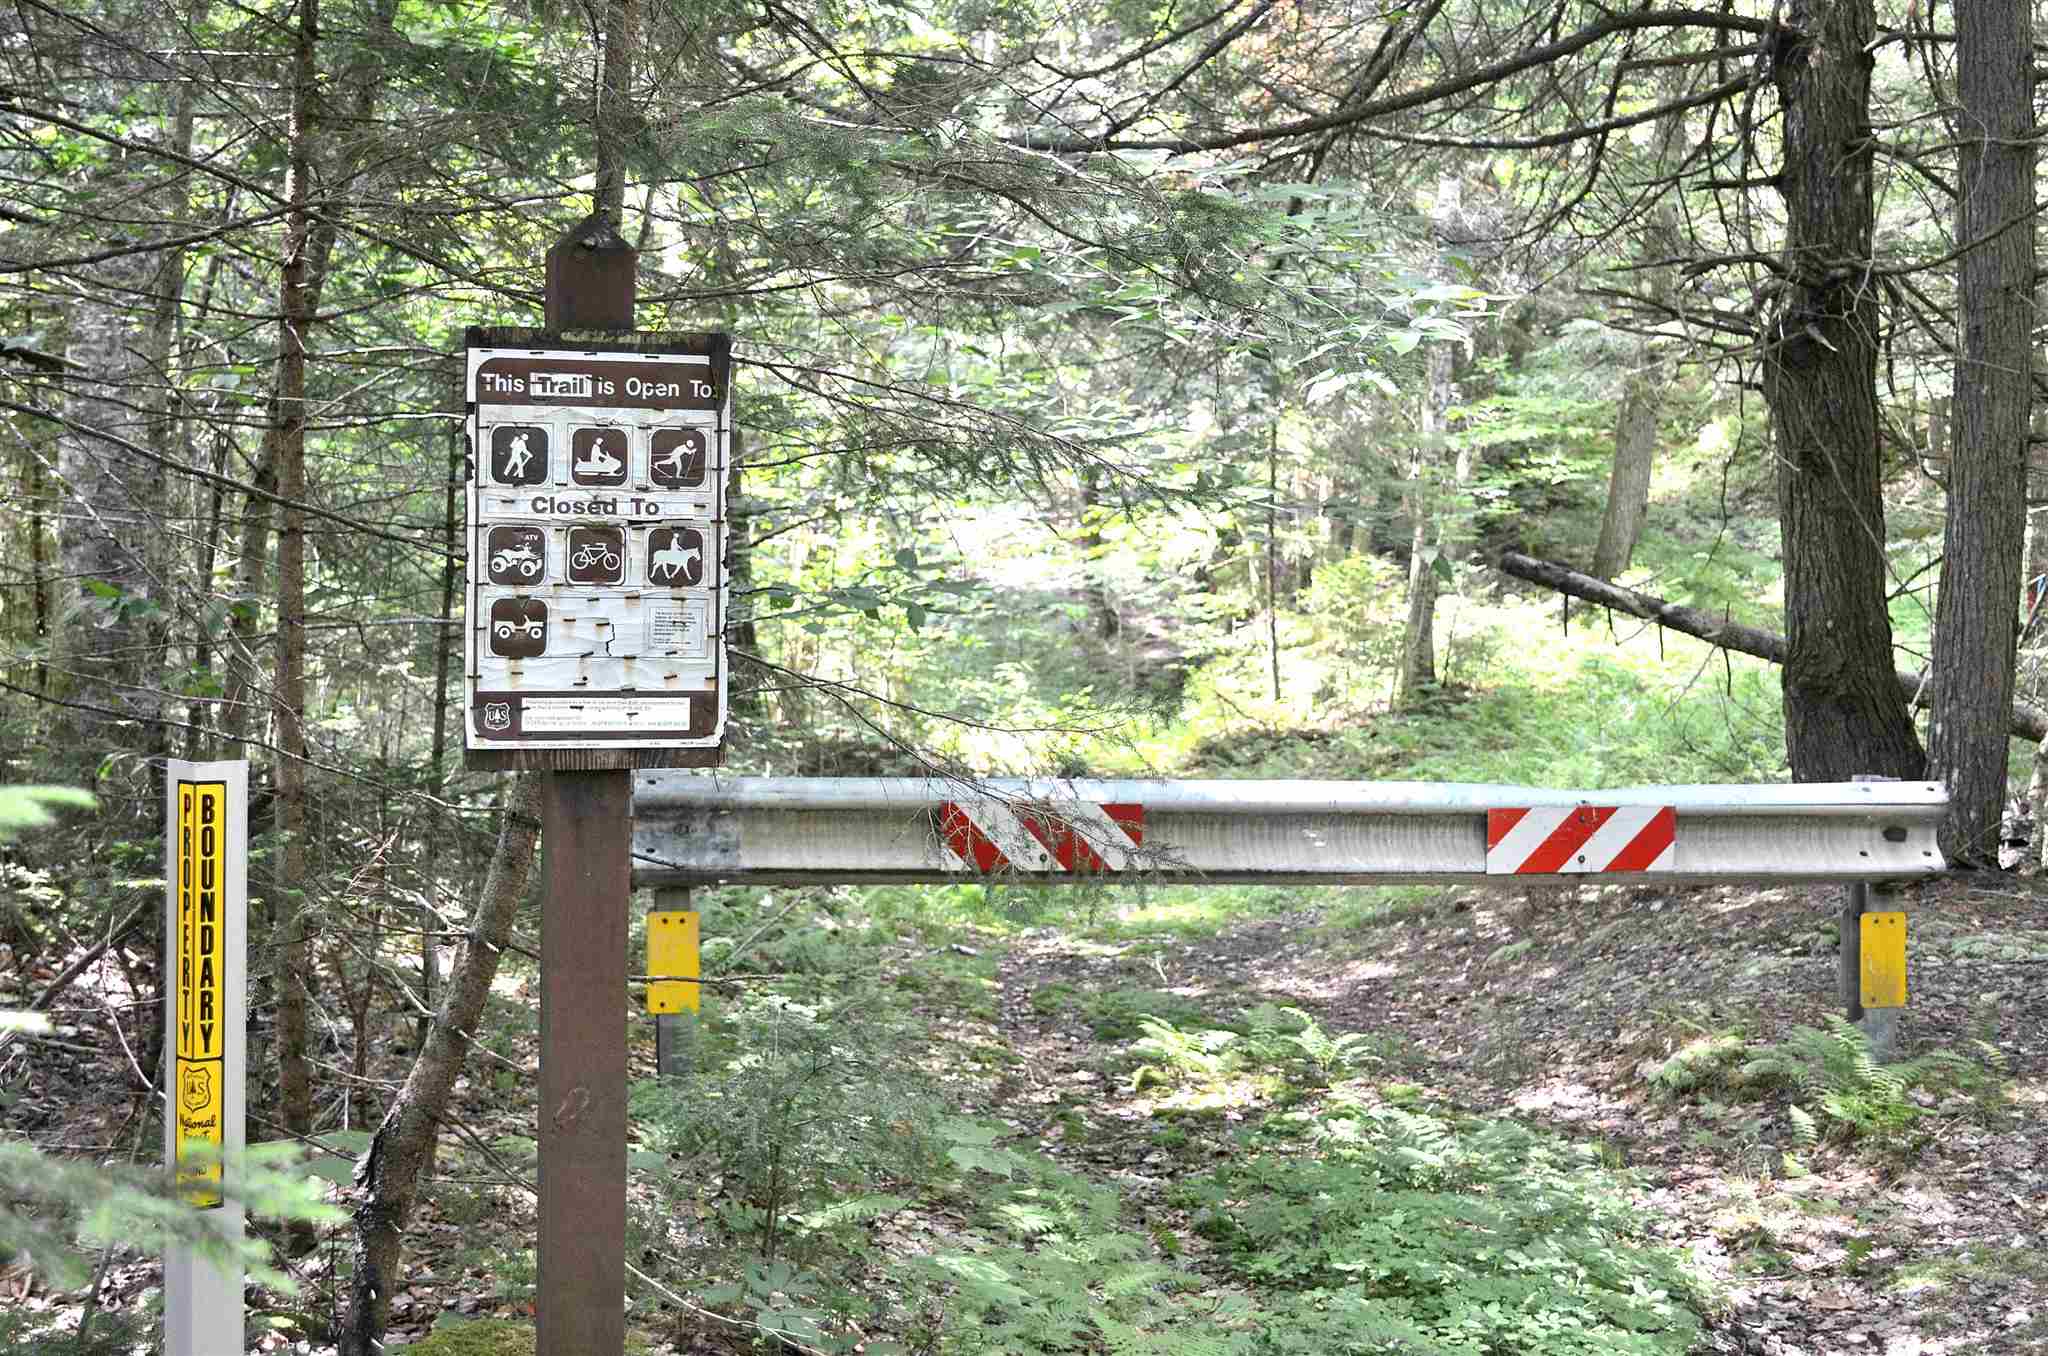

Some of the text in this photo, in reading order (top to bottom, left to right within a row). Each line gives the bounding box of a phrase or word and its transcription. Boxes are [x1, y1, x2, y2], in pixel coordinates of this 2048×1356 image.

[481, 373, 713, 399] This Trail is Open To
[531, 496, 660, 516] Closed To
[182, 793, 192, 1054] PROPERTY
[200, 793, 216, 1054] BOUNDARY
